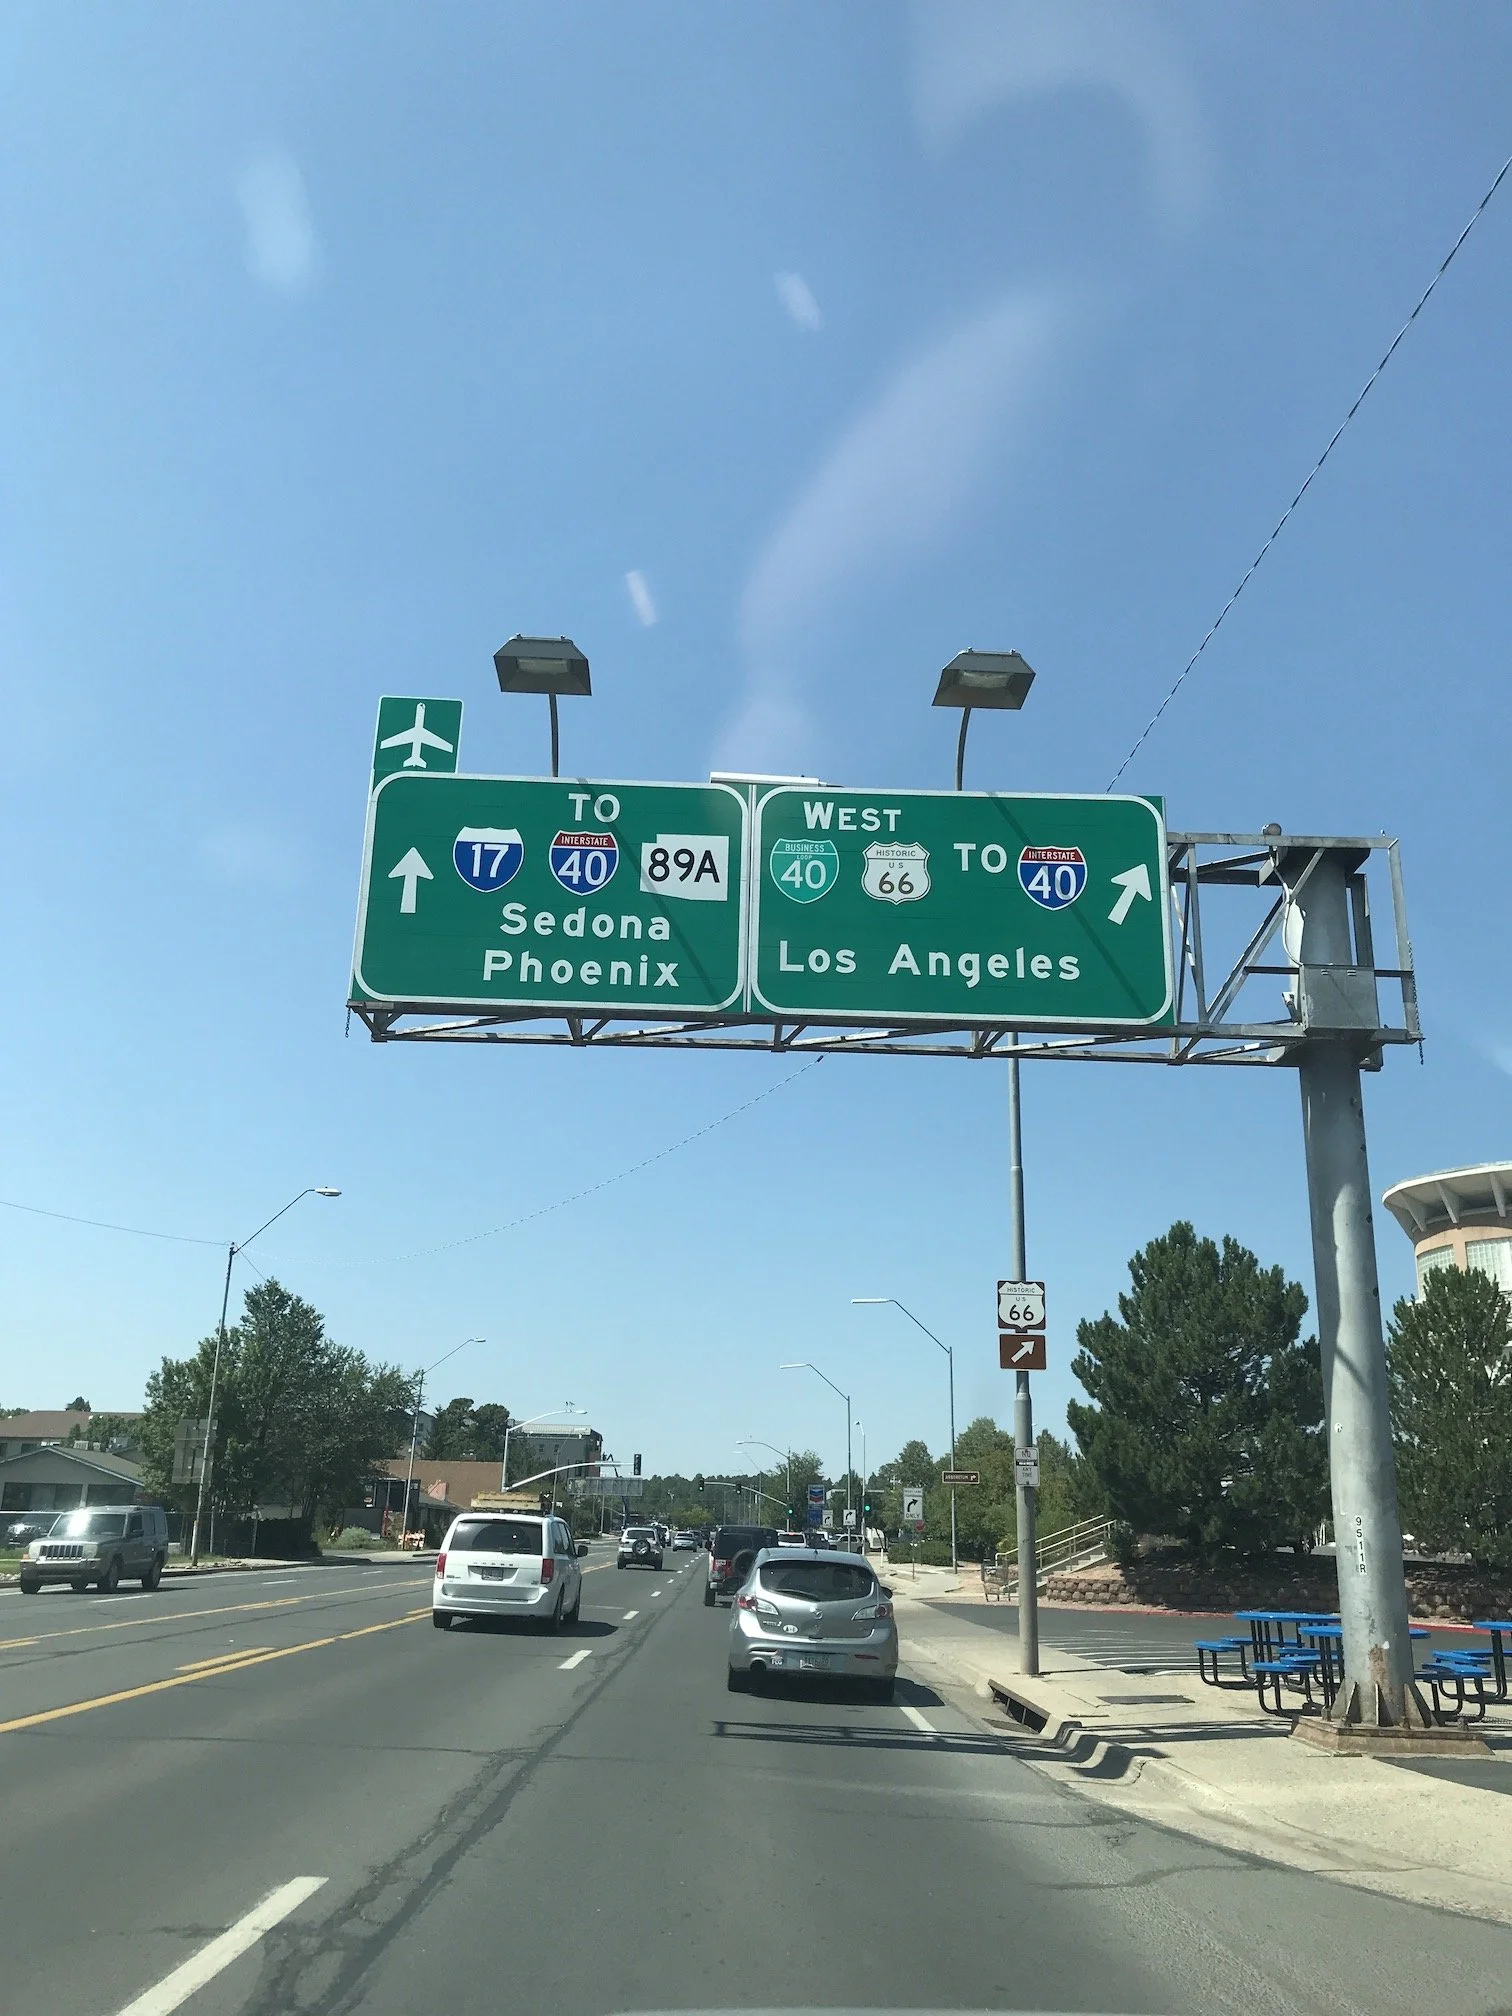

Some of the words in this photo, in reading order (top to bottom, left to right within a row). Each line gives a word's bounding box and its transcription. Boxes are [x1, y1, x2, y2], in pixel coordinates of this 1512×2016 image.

[568, 793, 622, 822] TO
[803, 801, 902, 832] WEST
[561, 836, 609, 847] INTERSTATE
[785, 843, 825, 853] BUSINESS
[876, 849, 916, 857] HISTORIC
[1028, 849, 1076, 861] INTERSTATE
[471, 843, 509, 878] 17
[558, 850, 608, 886] 40
[648, 847, 720, 883] 89A
[953, 843, 1008, 874] TO
[781, 860, 826, 889] 40
[878, 871, 914, 894] 66
[1027, 865, 1077, 901] 40
[500, 902, 670, 941] Sedona
[483, 949, 680, 987] Phoenix
[779, 940, 857, 974] Los
[888, 943, 1081, 989] Angeles
[1010, 1304, 1034, 1321] 66
[1355, 1516, 1366, 1573] 9511R
